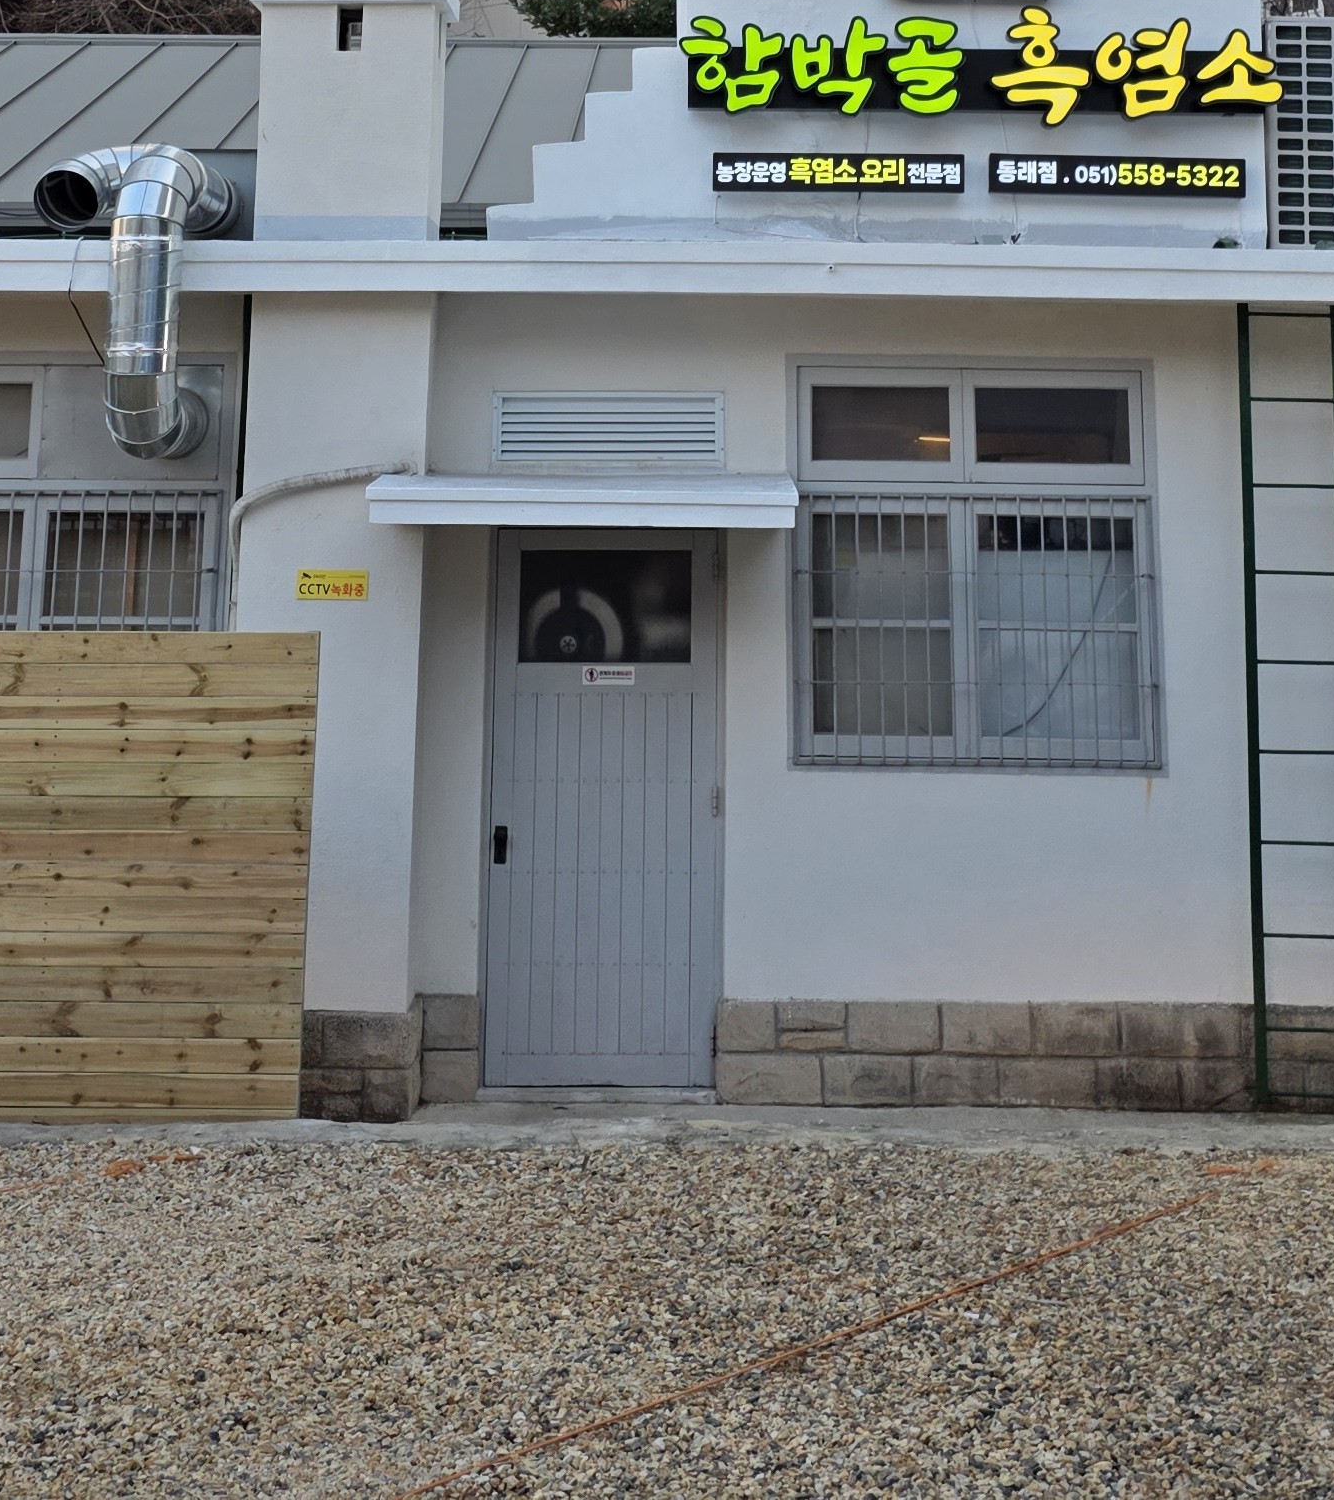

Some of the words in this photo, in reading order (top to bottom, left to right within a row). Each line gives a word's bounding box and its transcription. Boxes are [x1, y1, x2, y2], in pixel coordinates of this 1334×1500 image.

[679, 14, 965, 116] 함박골
[988, 4, 1287, 127] 흑염소
[716, 161, 786, 183] 농장운영
[789, 157, 857, 185] 흑염소
[859, 158, 905, 185] 요리
[907, 163, 960, 185] 전문점
[996, 160, 1057, 184] 동래점
[1074, 163, 1240, 188] 051)558-5322
